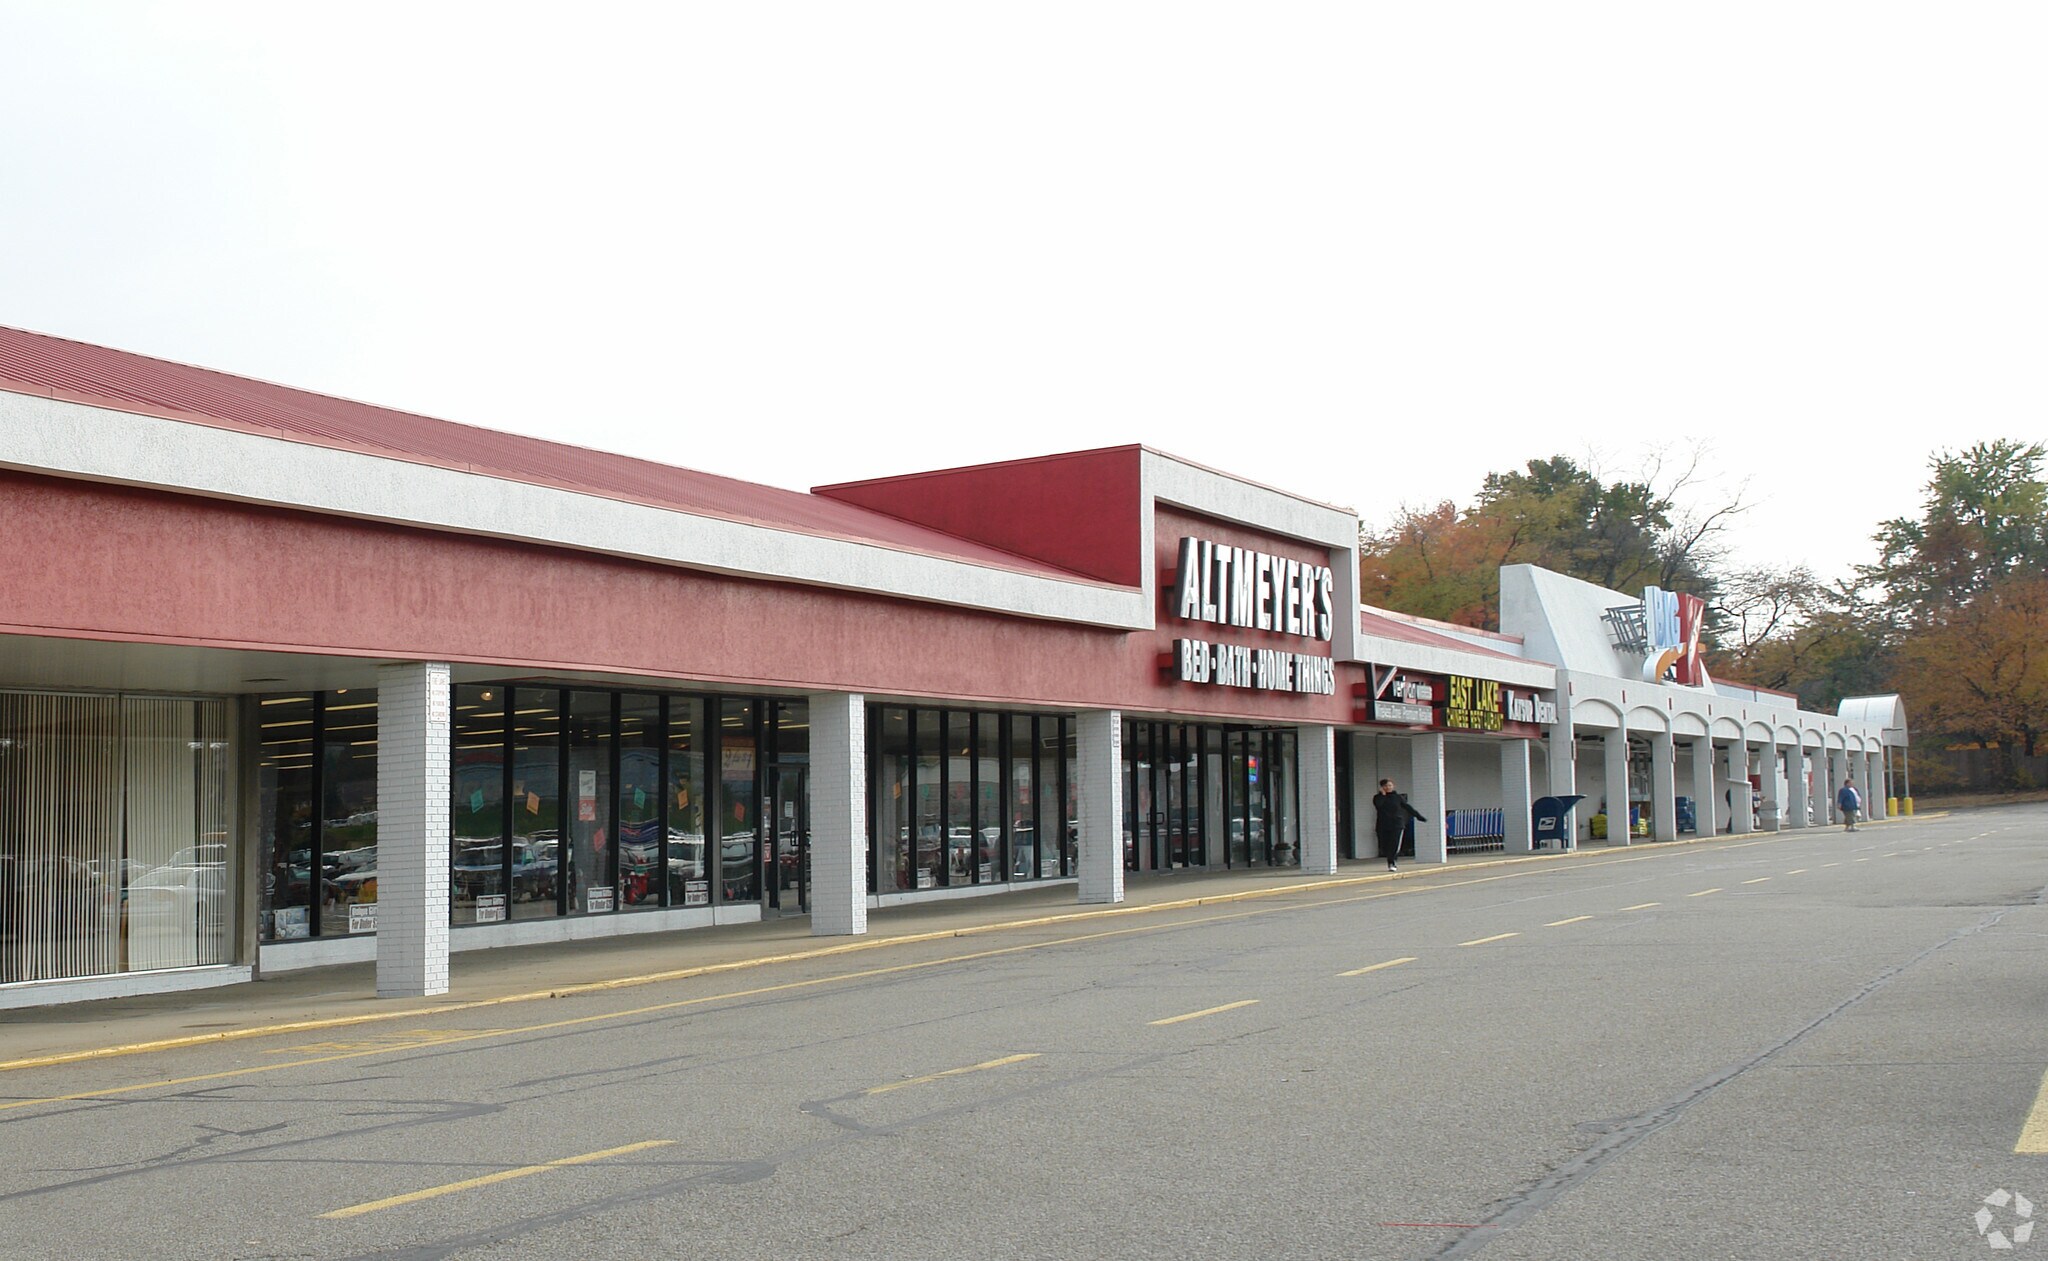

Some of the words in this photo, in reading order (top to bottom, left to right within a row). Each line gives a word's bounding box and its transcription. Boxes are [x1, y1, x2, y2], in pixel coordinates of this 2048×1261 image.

[1178, 536, 1334, 642] ALTMEYER'S
[1295, 653, 1336, 696] THINGS
[1449, 675, 1473, 710] EAST
[1475, 679, 1500, 713] LAKE
